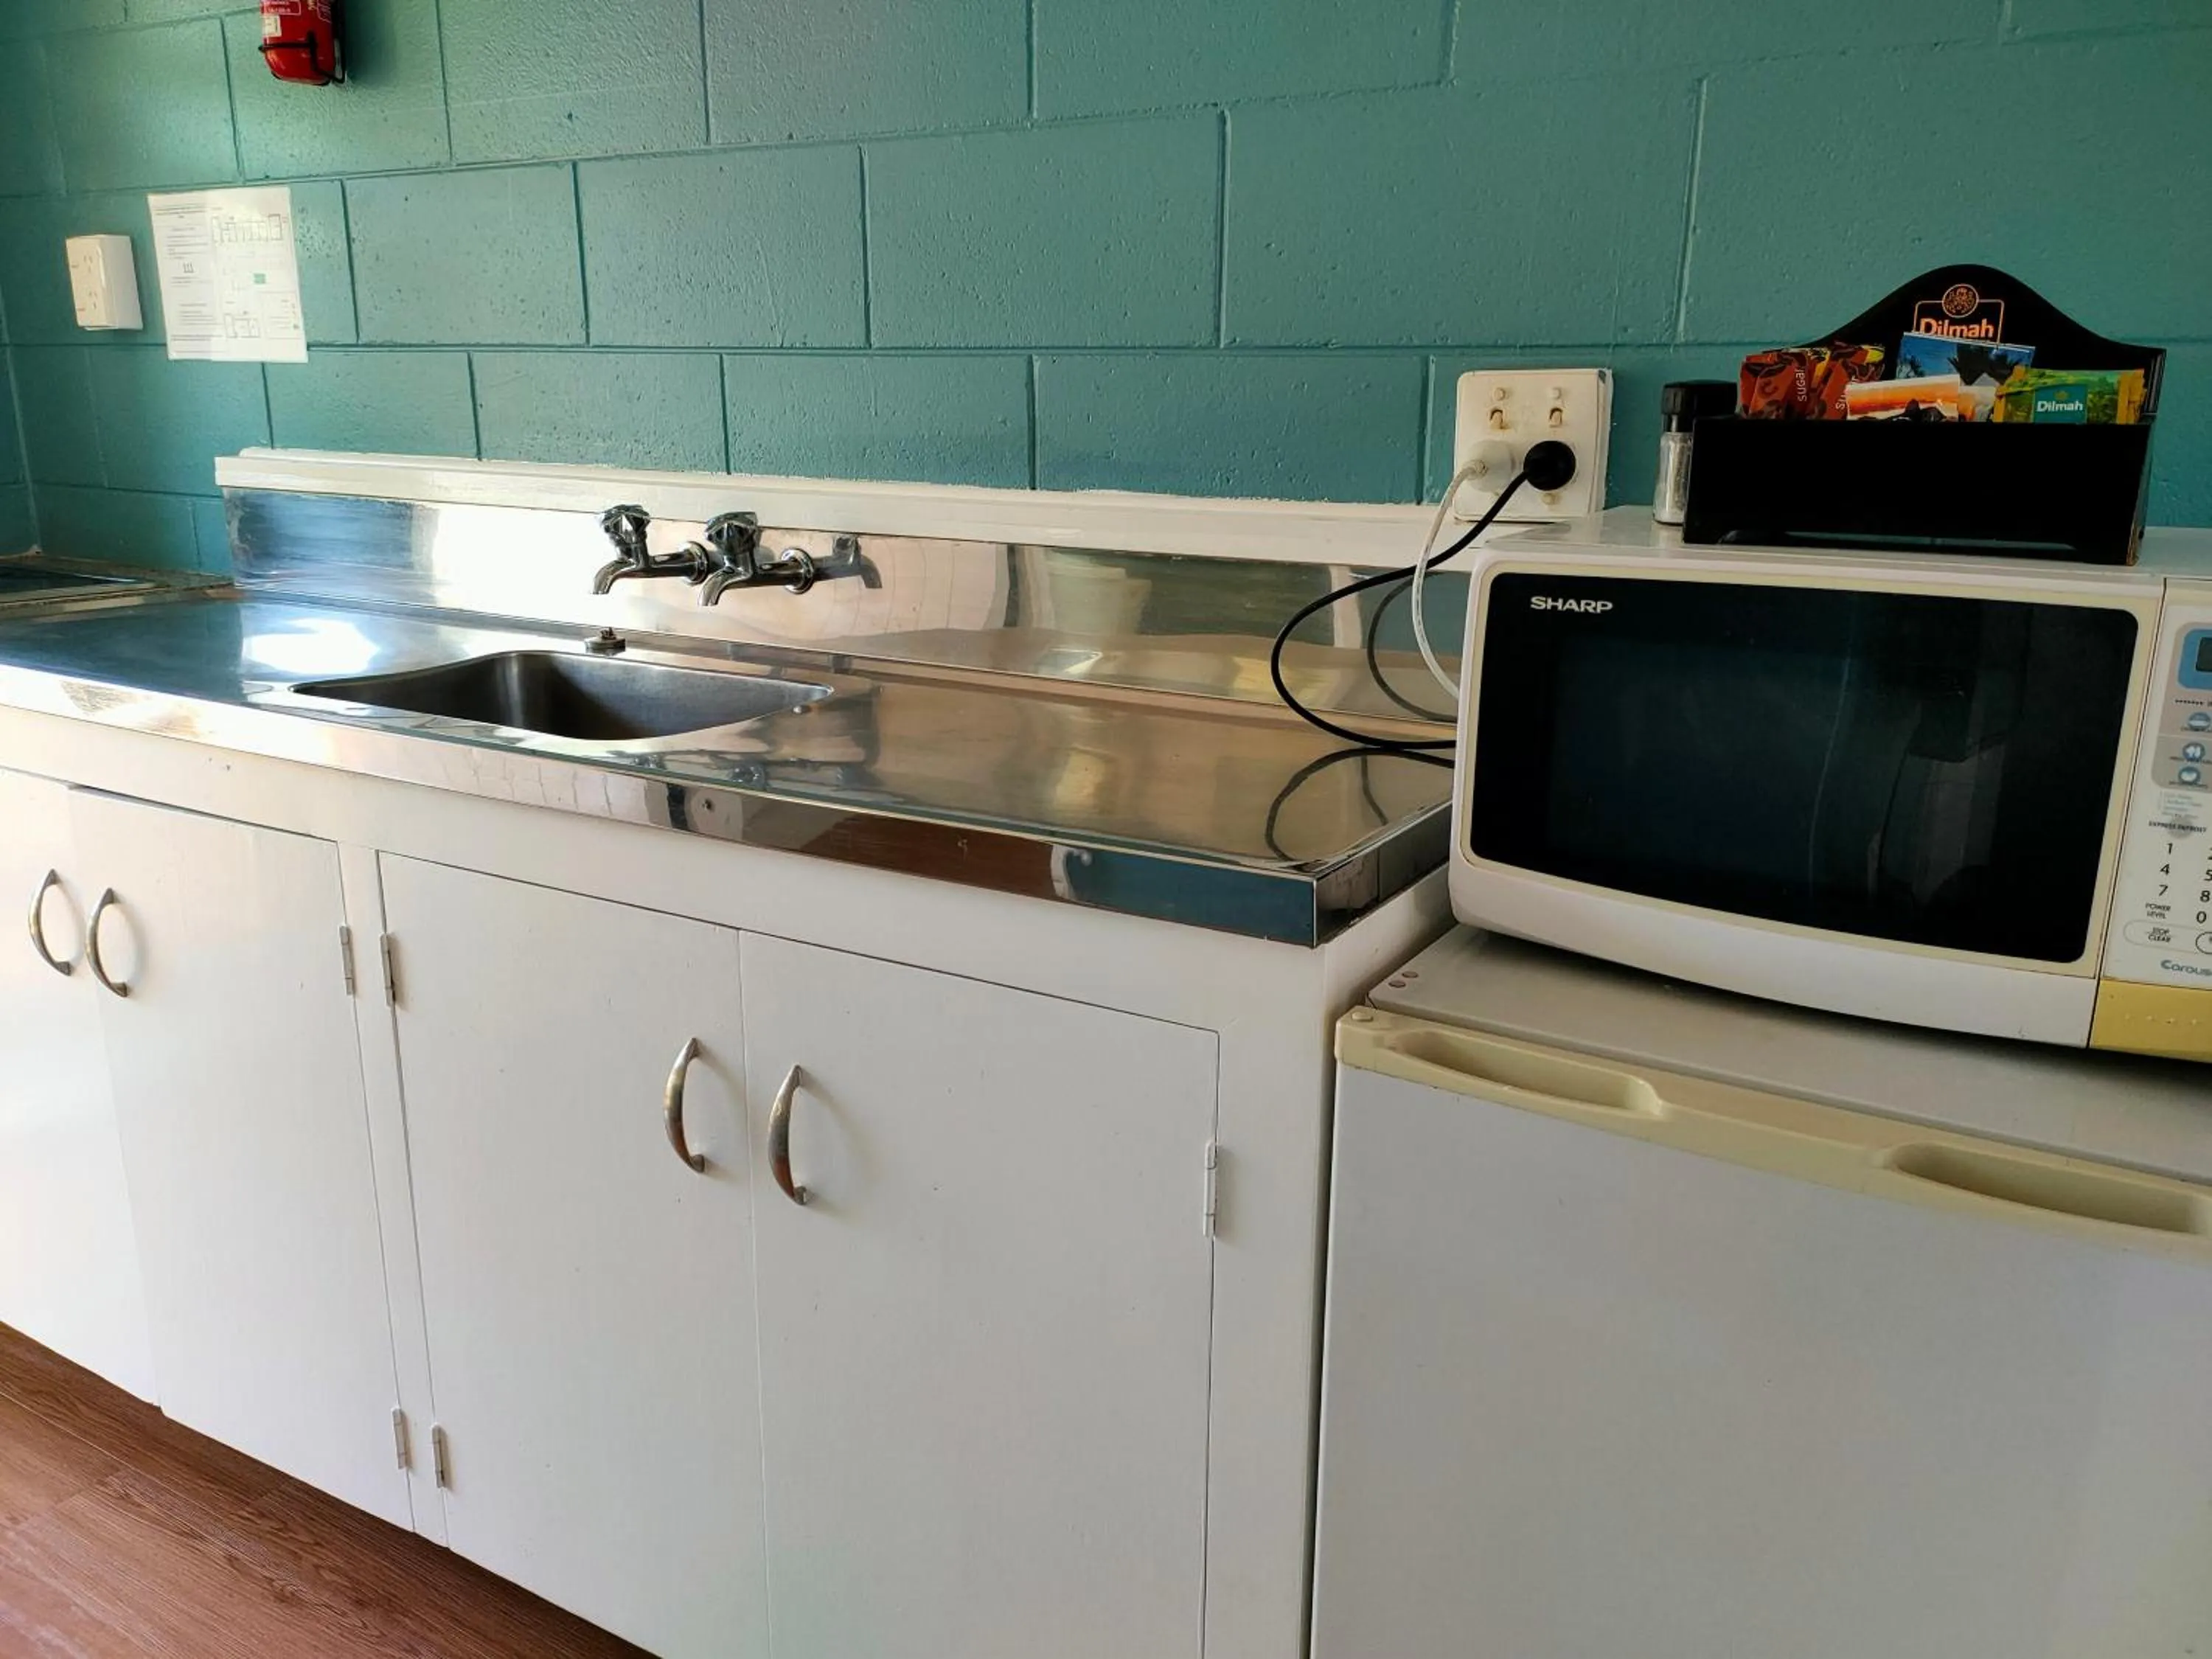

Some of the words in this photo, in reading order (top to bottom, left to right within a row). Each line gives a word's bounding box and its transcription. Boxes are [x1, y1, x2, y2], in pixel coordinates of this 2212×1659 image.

[1919, 318, 1994, 338] Dilmah
[2037, 400, 2084, 412] Dilmah
[1530, 595, 1613, 613] SHARP
[2168, 843, 2173, 855] 1
[2160, 863, 2170, 875] 4
[2158, 884, 2168, 897] 7
[2199, 890, 2211, 902] 8
[2145, 902, 2171, 911] POWER
[2196, 911, 2207, 924] 0
[2148, 933, 2171, 942] CLEAR
